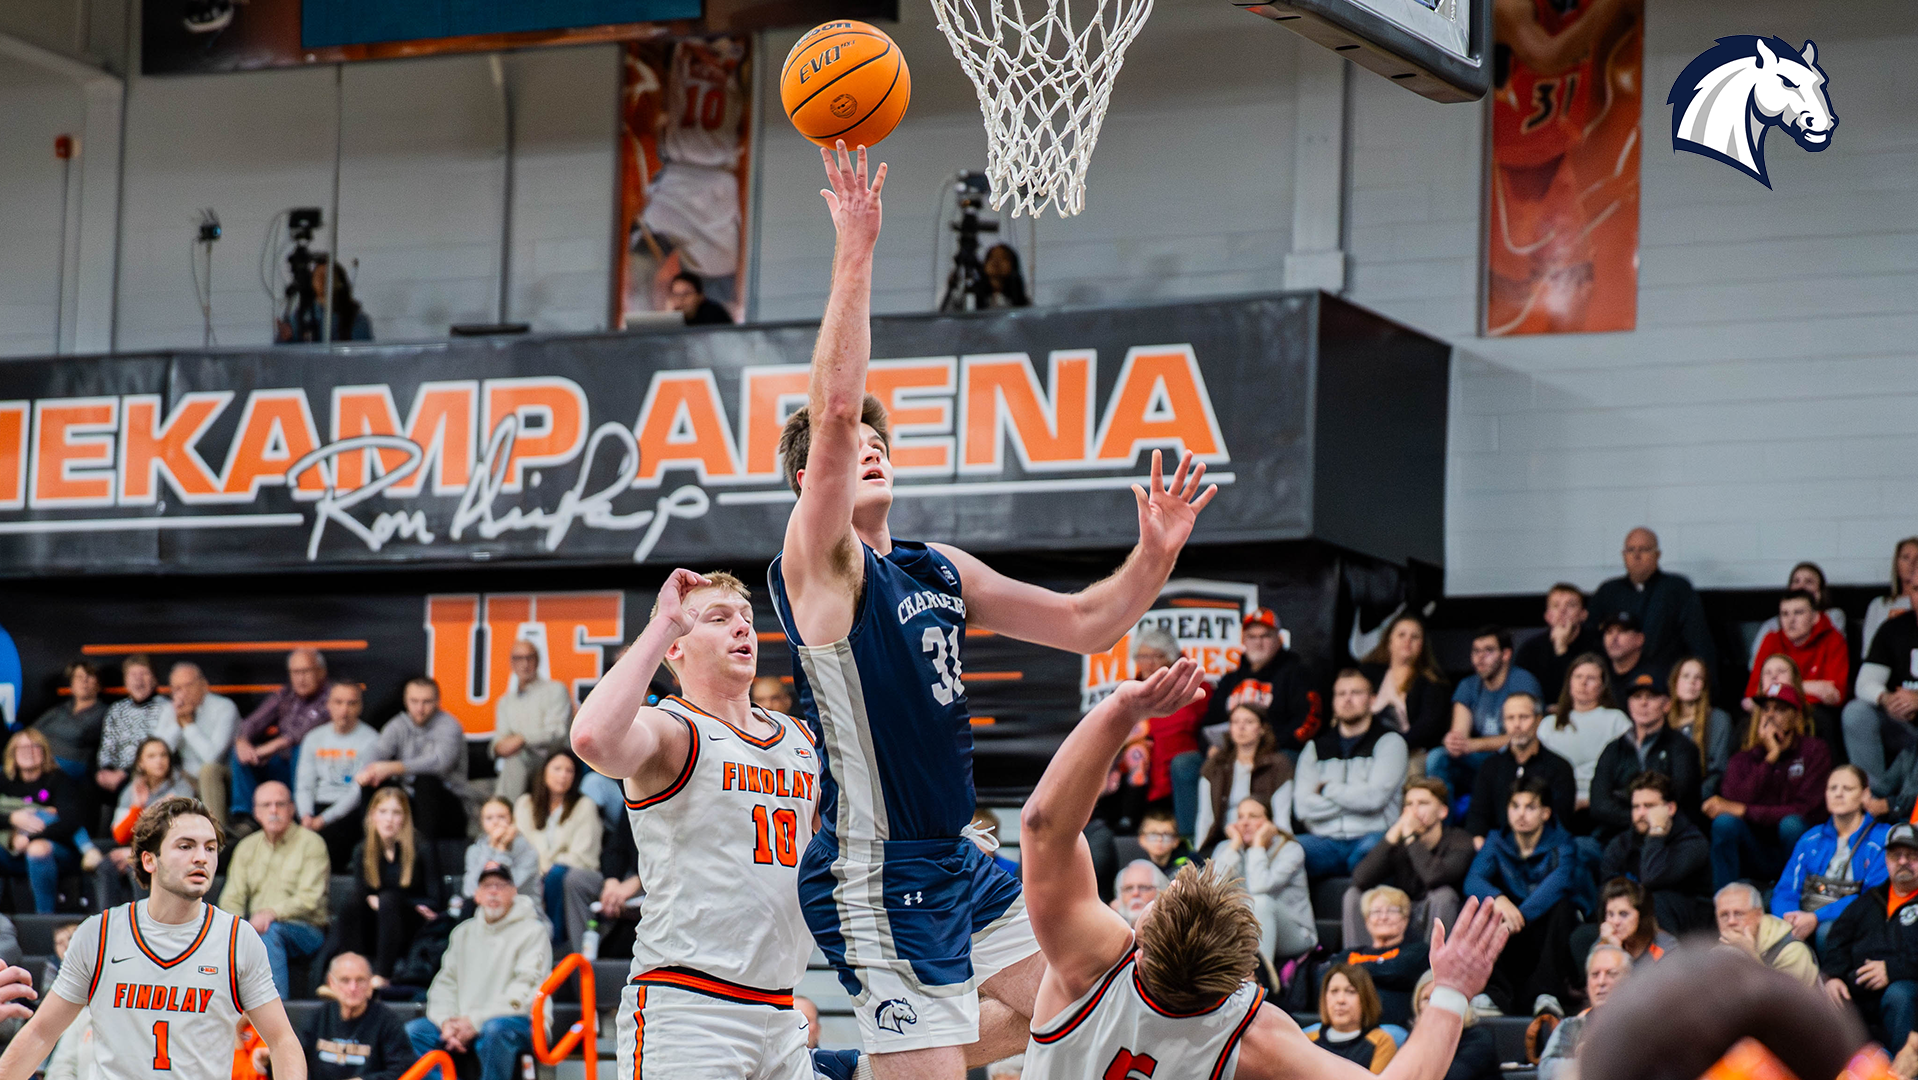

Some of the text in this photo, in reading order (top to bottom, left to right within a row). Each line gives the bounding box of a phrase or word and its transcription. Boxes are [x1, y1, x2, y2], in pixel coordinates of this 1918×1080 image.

[799, 45, 841, 85] EVO
[680, 84, 725, 132] 10
[1521, 72, 1580, 135] 31
[722, 761, 815, 801] FINDLAY
[752, 803, 798, 868] 10
[113, 983, 215, 1013] FINDLAY
[152, 1020, 172, 1071] 1
